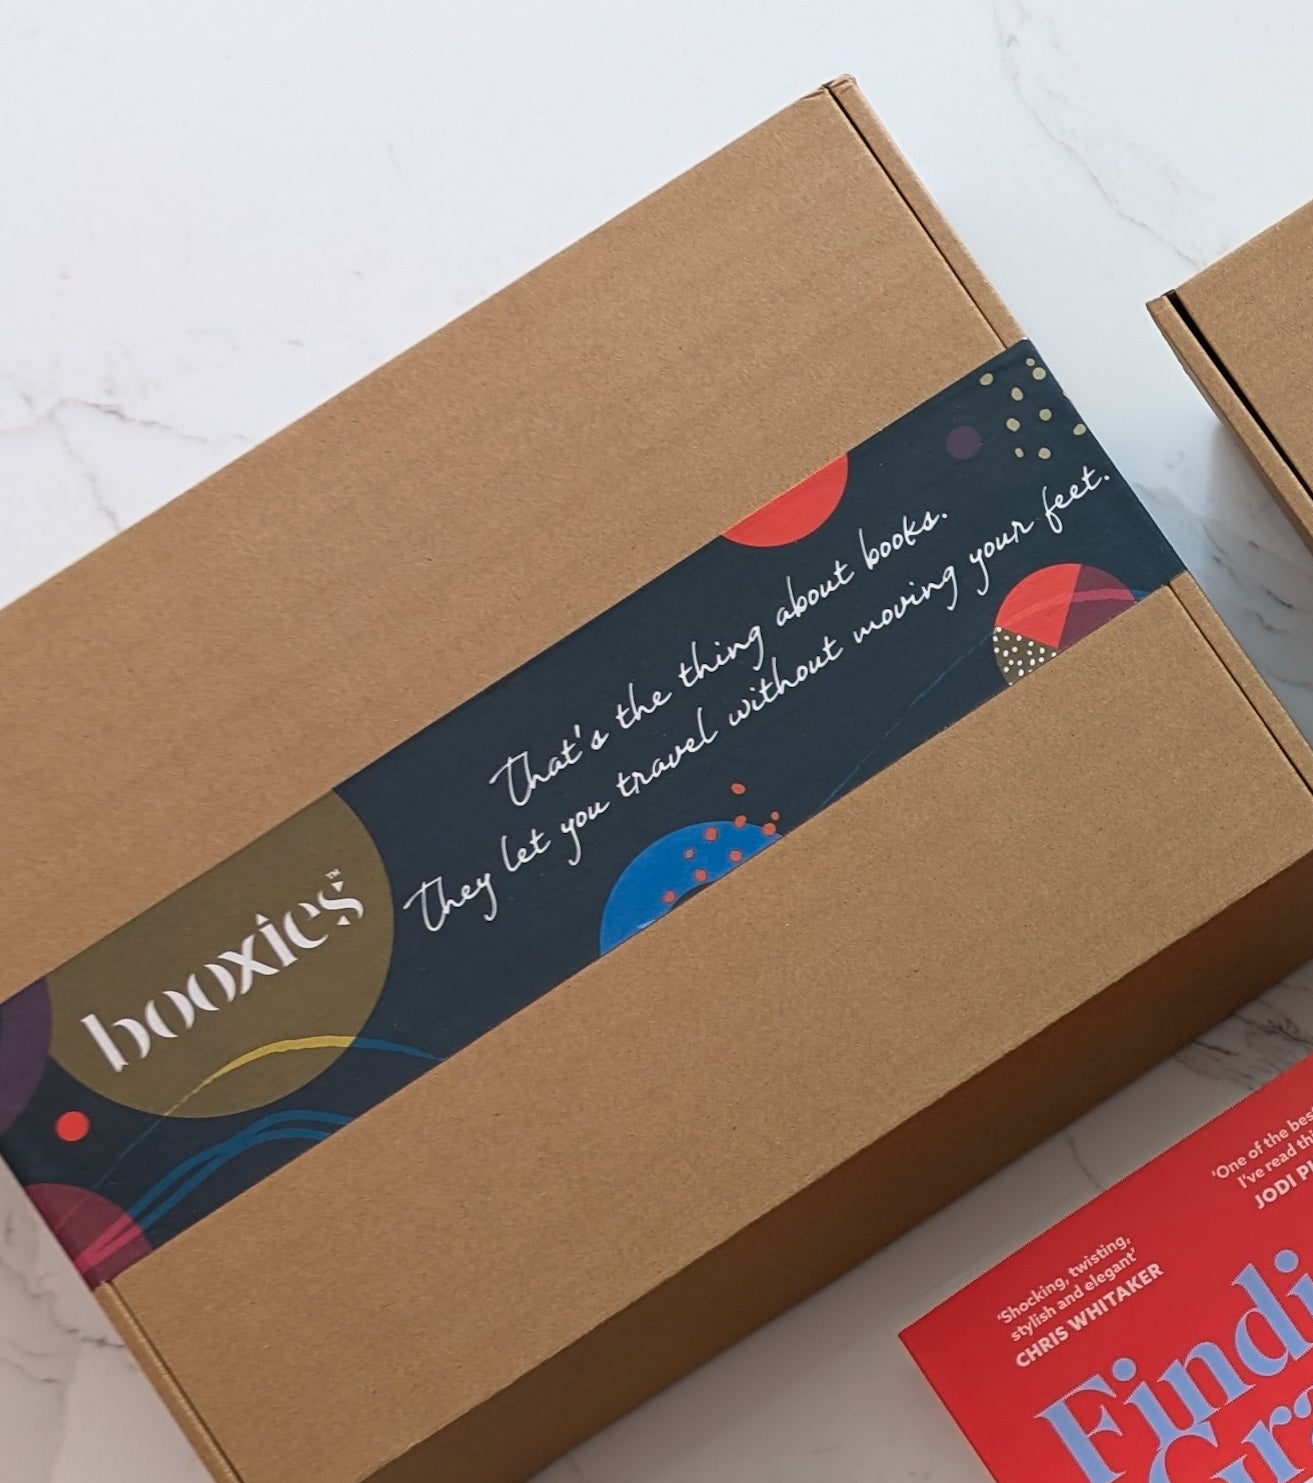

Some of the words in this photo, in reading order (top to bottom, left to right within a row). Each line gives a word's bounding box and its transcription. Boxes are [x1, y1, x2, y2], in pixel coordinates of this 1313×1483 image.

[488, 723, 610, 807] That's
[615, 684, 673, 729] the
[678, 624, 765, 688] thing
[776, 559, 855, 627] about
[858, 510, 949, 570] books.
[403, 872, 498, 932] They
[501, 827, 552, 873] let
[560, 801, 611, 867] you
[616, 706, 719, 797] travel
[728, 635, 844, 727] without
[853, 565, 959, 644] moving
[968, 520, 1036, 596] your
[1254, 1172, 1298, 1210] JODI
[1067, 1235, 1132, 1278] twisting,
[1010, 1305, 1058, 1342] stylish
[1056, 1283, 1085, 1310] and
[1015, 1325, 1069, 1367] CHRIS
[1066, 1262, 1165, 1331] WHITAKER
